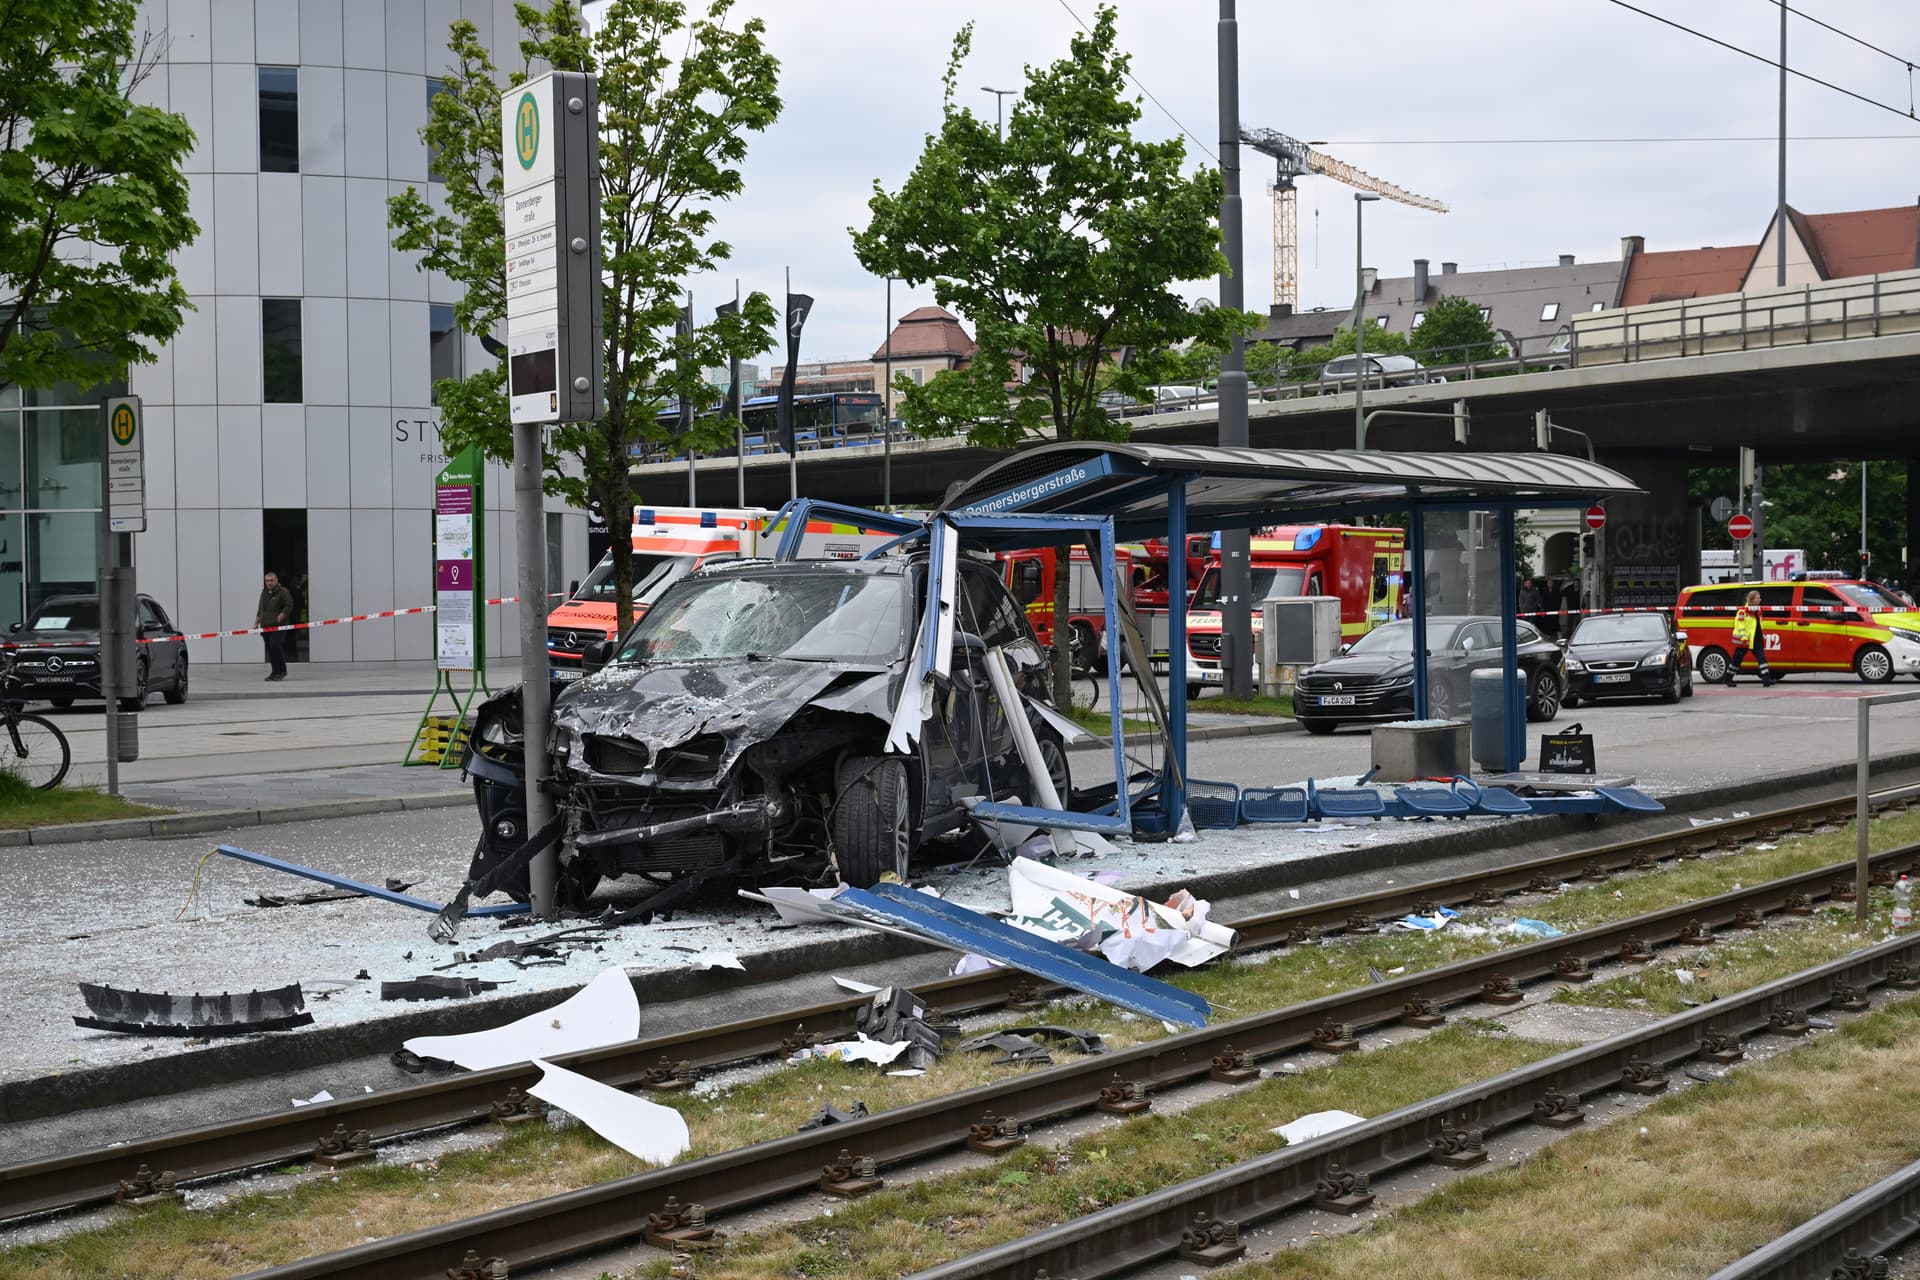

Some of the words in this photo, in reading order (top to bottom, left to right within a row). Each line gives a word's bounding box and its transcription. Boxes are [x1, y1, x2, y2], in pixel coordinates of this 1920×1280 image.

[521, 109, 534, 154] H
[117, 413, 130, 437] H
[395, 419, 446, 442] STY
[420, 453, 453, 464] FRISE
[588, 526, 609, 535] smart
[1763, 633, 1781, 651] 12
